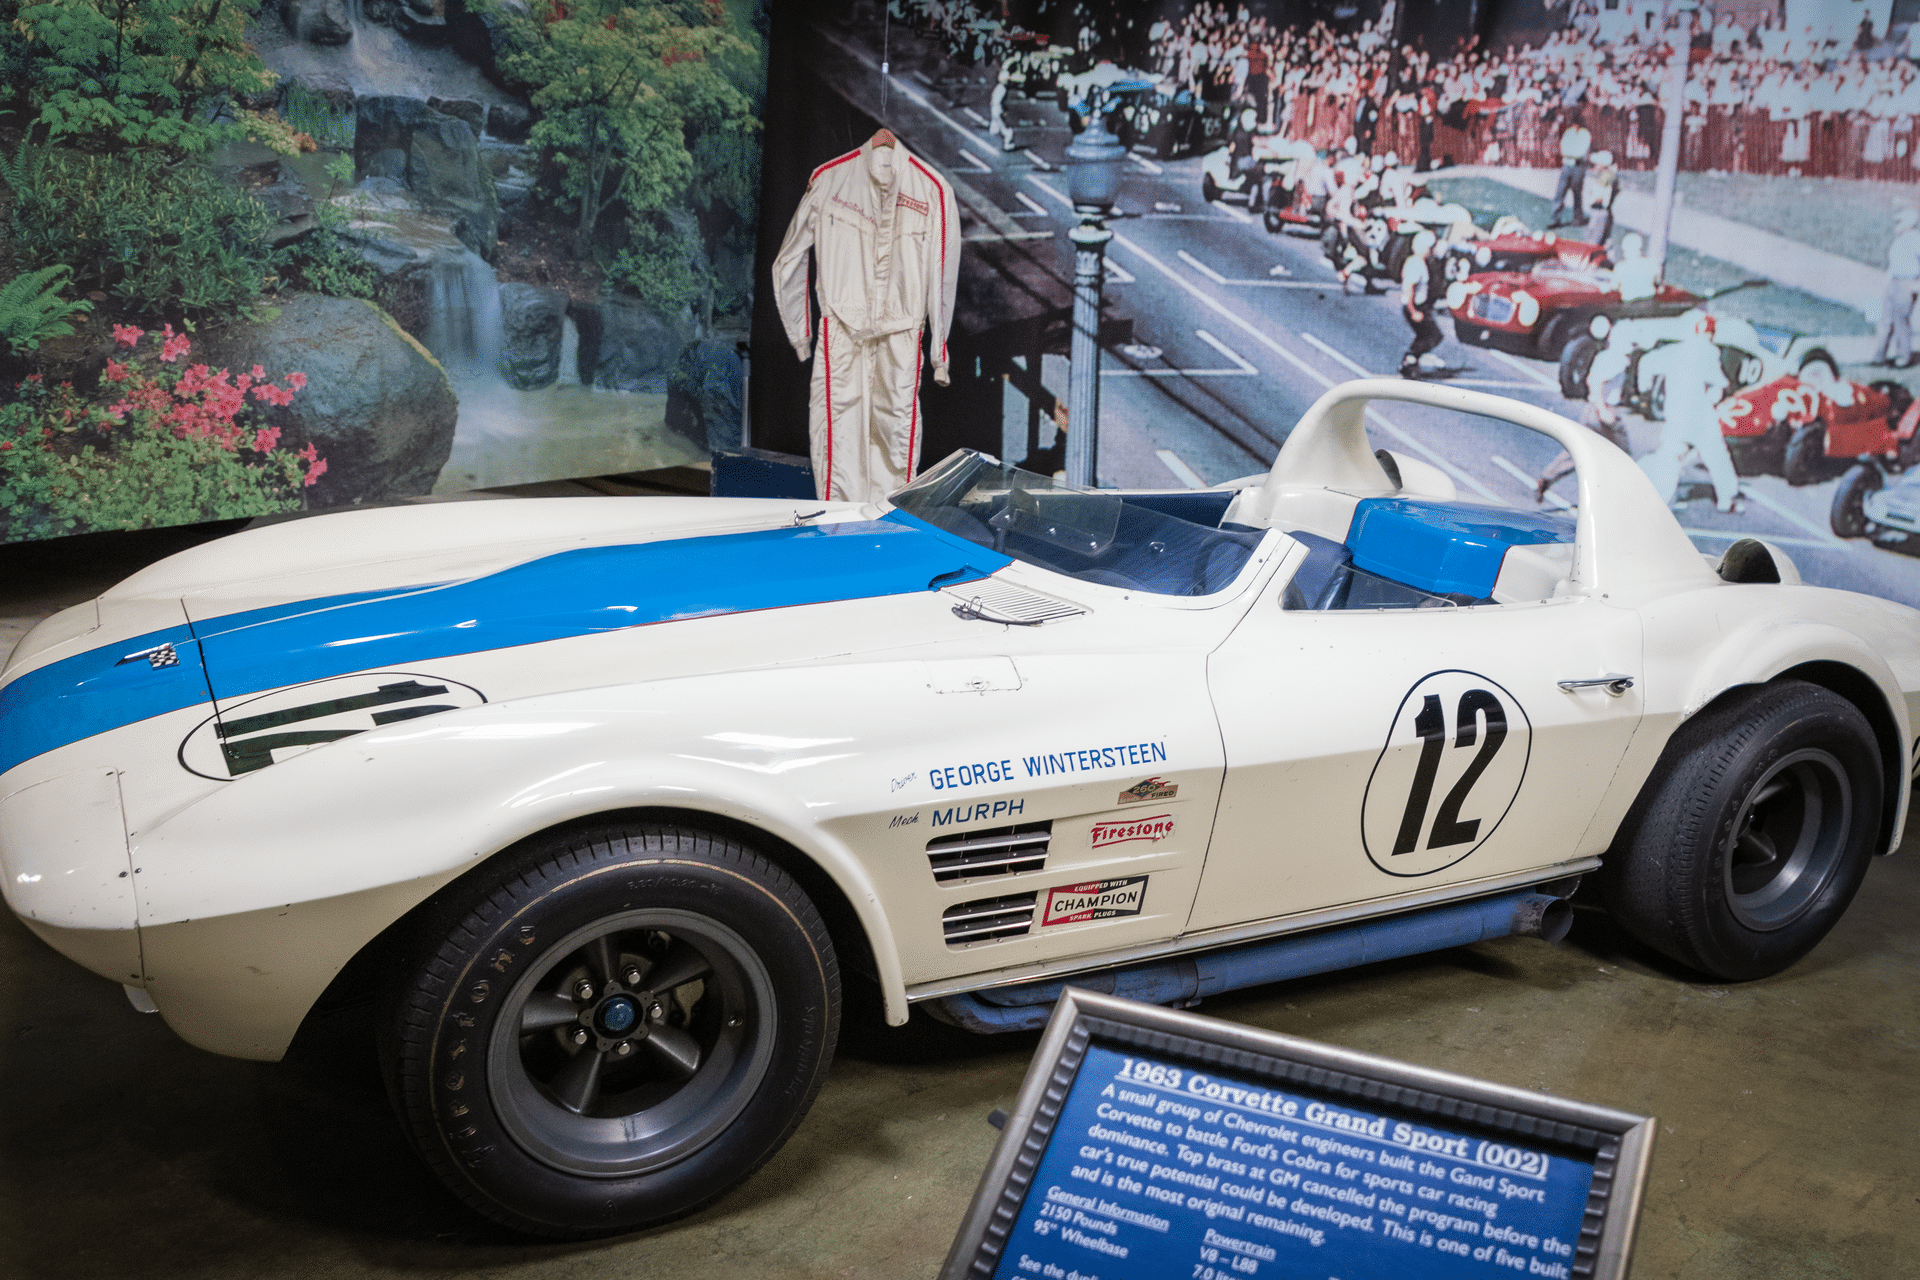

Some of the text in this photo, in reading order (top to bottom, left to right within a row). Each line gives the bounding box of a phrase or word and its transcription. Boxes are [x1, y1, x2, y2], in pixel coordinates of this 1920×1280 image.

[929, 759, 1014, 790] GEORGE
[1022, 741, 1167, 777] WINTERSTEEN
[1391, 689, 1508, 857] 12
[1132, 785, 1156, 794] 260
[931, 798, 1024, 827] MURPH
[1090, 820, 1174, 844] Firestone
[1054, 890, 1138, 912] CHAMPION
[1074, 879, 1128, 892] EQUIPPED WITH
[1069, 909, 1117, 922] SPARK PLUGS
[1118, 1058, 1549, 1179] 1963 Corvette Grand Sport (002)
[1100, 1083, 1546, 1203] A small group of Chevrolet engineers built the Gand Sport
[1097, 1103, 1498, 1219] Corvette to battle Ford's Cobra for sports car racing
[1071, 1165, 1326, 1247] and is the most original remaining.
[1088, 1123, 1572, 1257] dominance. Top brass at GM cancelled the program before the
[1040, 1201, 1118, 1236] 2150 Pounds
[1047, 1186, 1170, 1231] General Information
[1079, 1145, 1568, 1280] car's true potential could be developed. This is one of five built
[1061, 1226, 1129, 1259] Wheelbase
[1204, 1228, 1277, 1260] Powertrain
[1018, 1254, 1042, 1273] See
[1043, 1262, 1065, 1280] the
[1200, 1245, 1219, 1264] V8
[1231, 1255, 1258, 1275] L88
